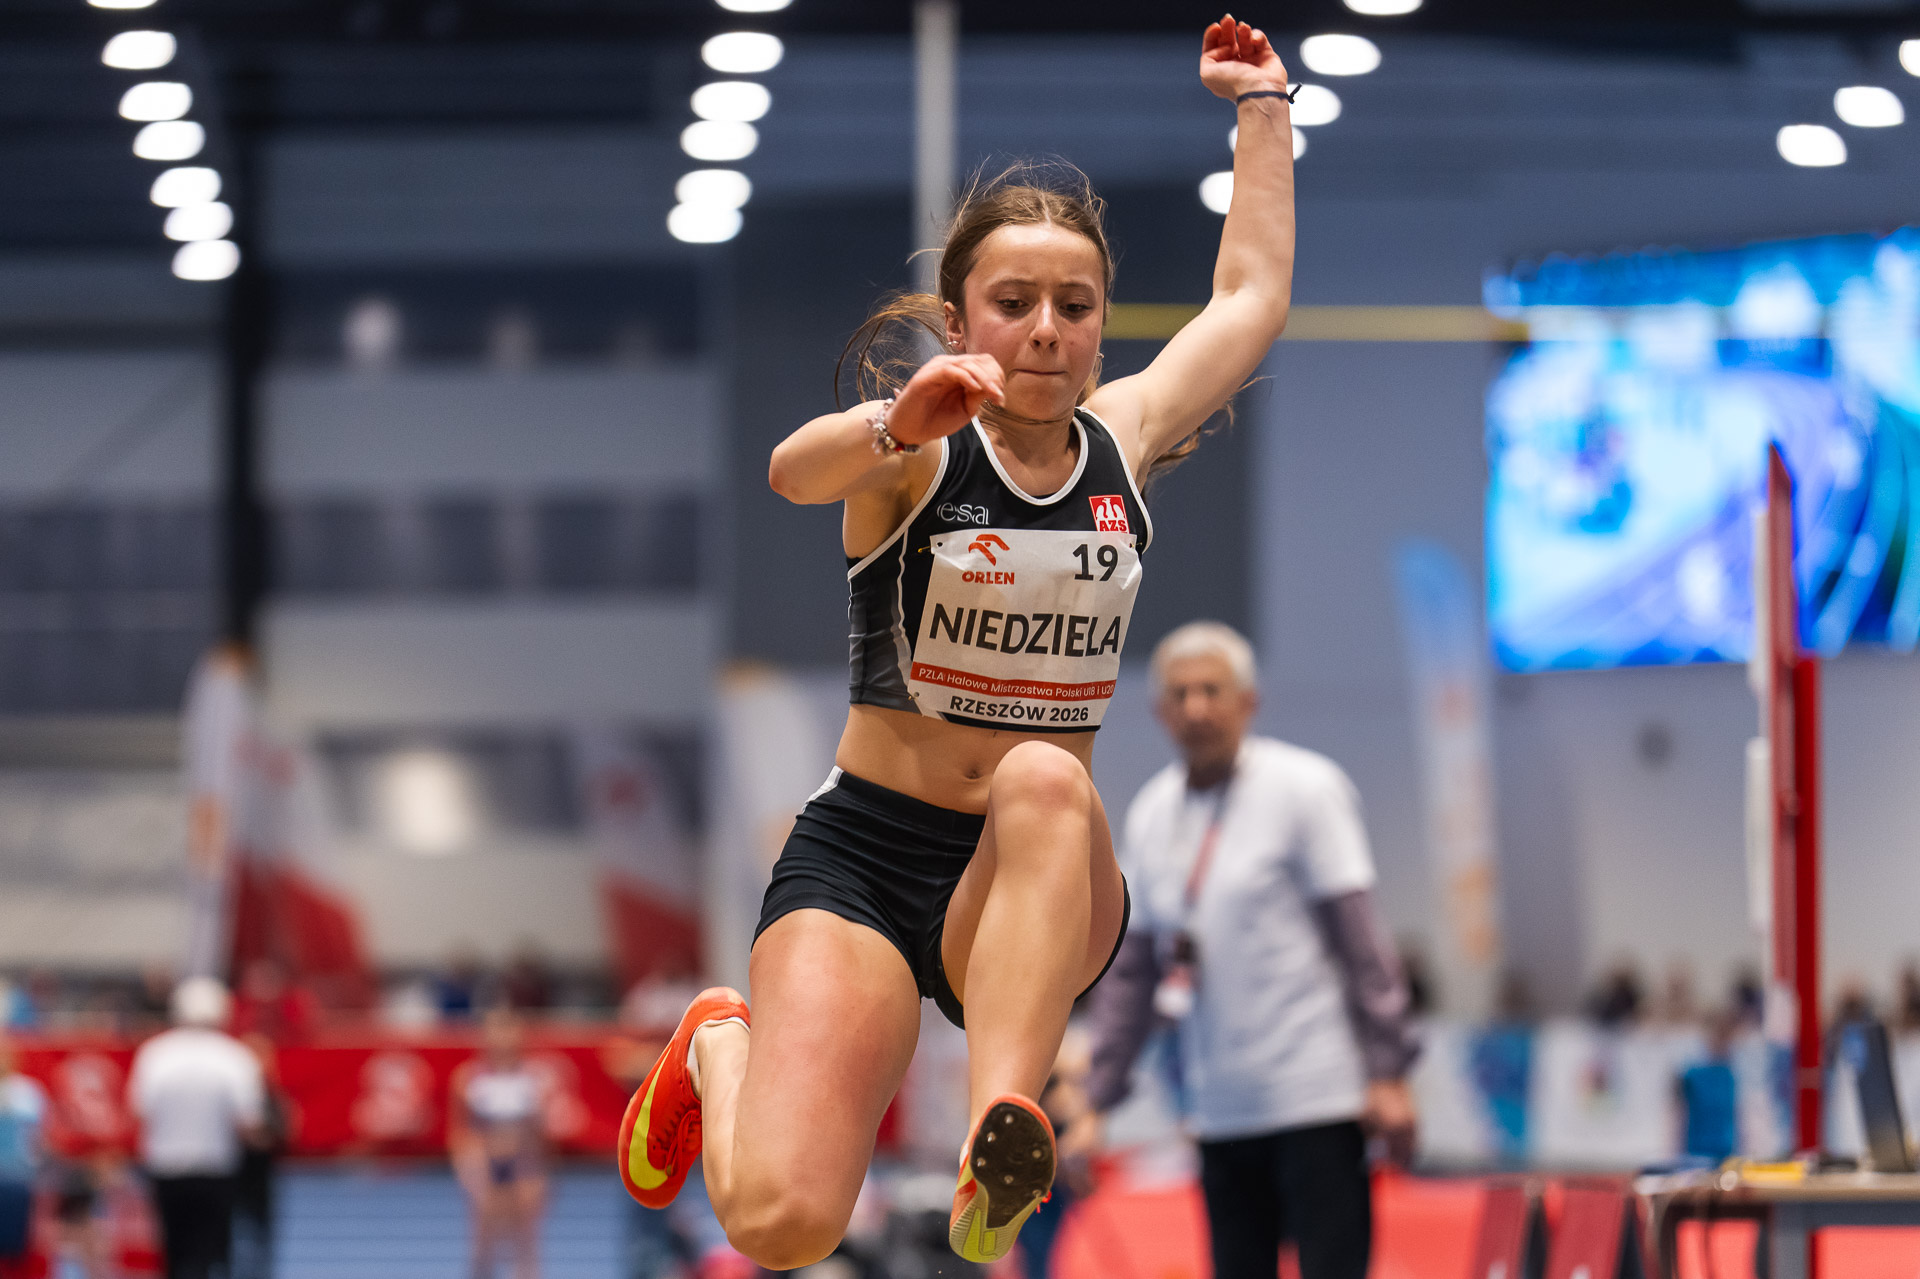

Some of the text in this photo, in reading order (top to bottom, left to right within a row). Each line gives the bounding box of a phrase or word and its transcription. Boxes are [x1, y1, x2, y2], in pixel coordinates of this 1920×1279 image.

[1099, 519, 1127, 532] AZS
[1072, 543, 1119, 582] 19
[962, 571, 1015, 585] ORLEN
[929, 602, 1121, 657] NIEDZIELA
[918, 667, 944, 682] PZLA
[946, 673, 988, 690] Halowe
[990, 683, 1053, 697] Mistrzostwa
[1055, 687, 1082, 698] Polski
[1083, 686, 1096, 697] U18
[1101, 684, 1115, 695] U20
[950, 695, 1089, 722] RZESZÓW 2026
